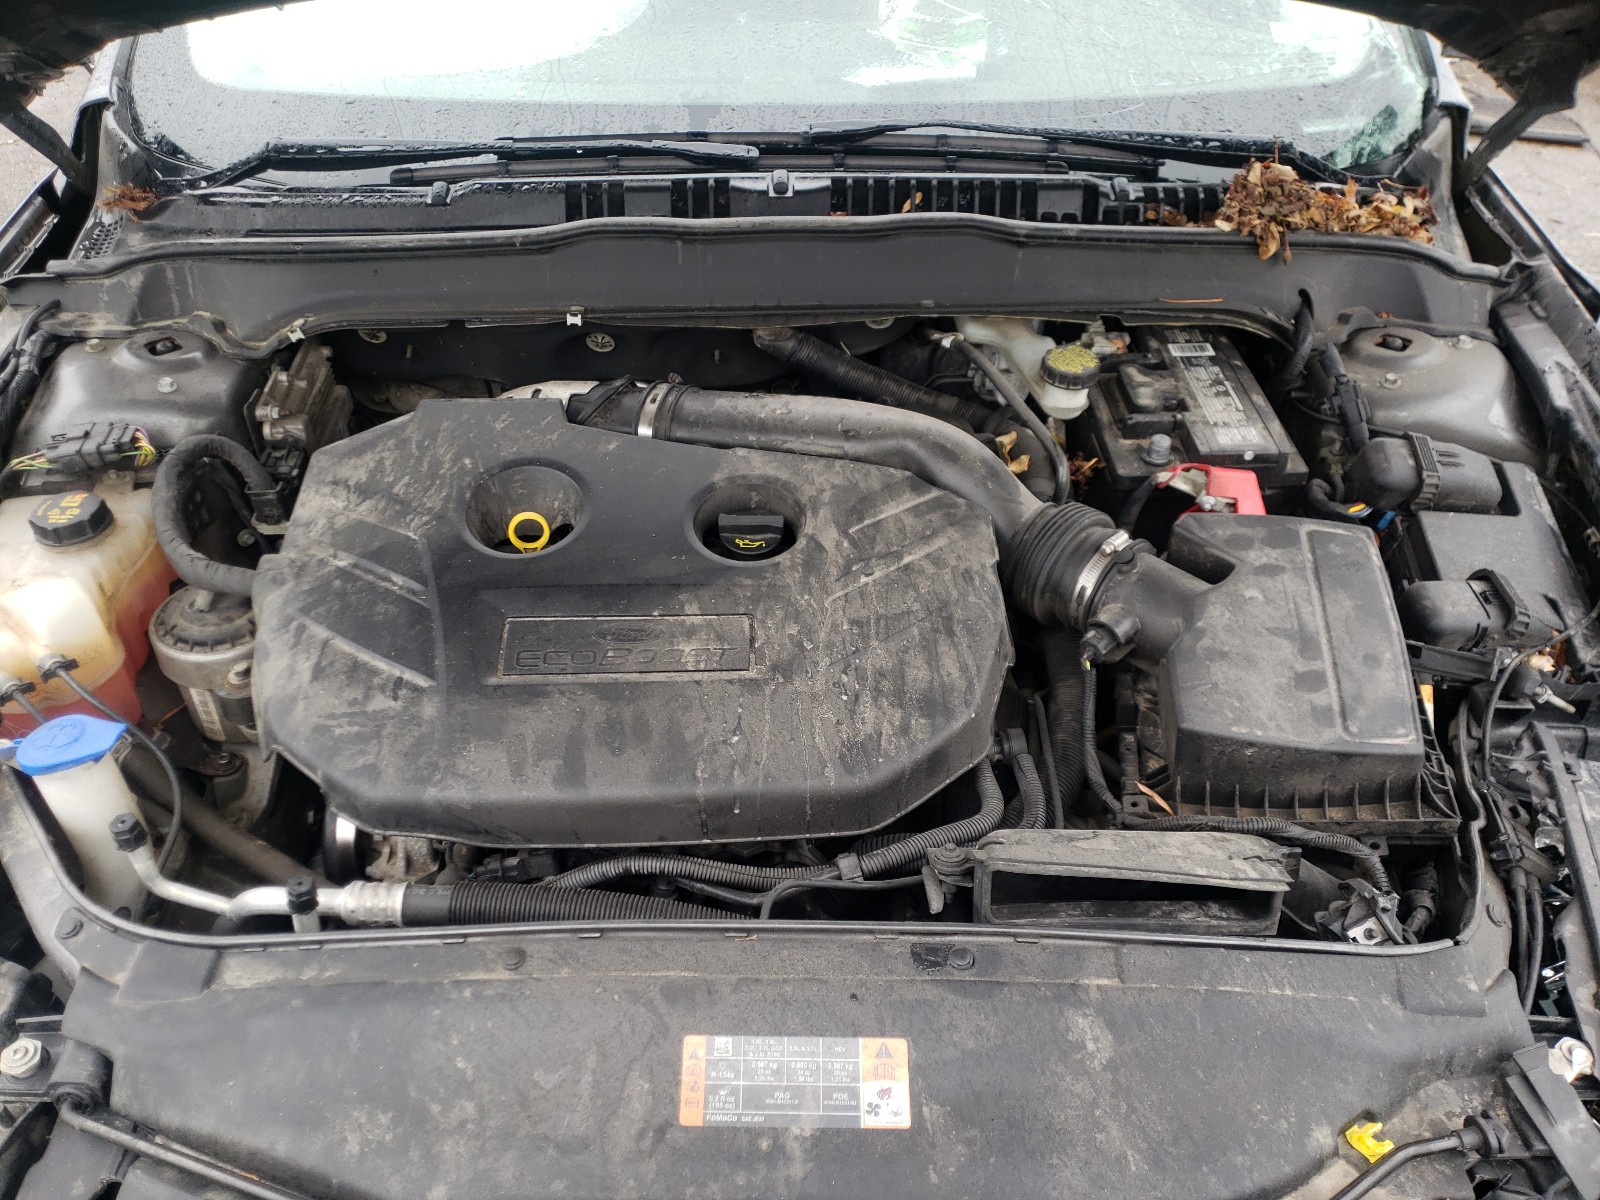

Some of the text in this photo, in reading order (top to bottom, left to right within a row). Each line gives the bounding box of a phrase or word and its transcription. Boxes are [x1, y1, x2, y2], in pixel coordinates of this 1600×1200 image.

[769, 1061, 778, 1070] kg
[845, 1062, 853, 1071] kg
[774, 1092, 791, 1100] PAG
[706, 1113, 738, 1121] FoMoCo
